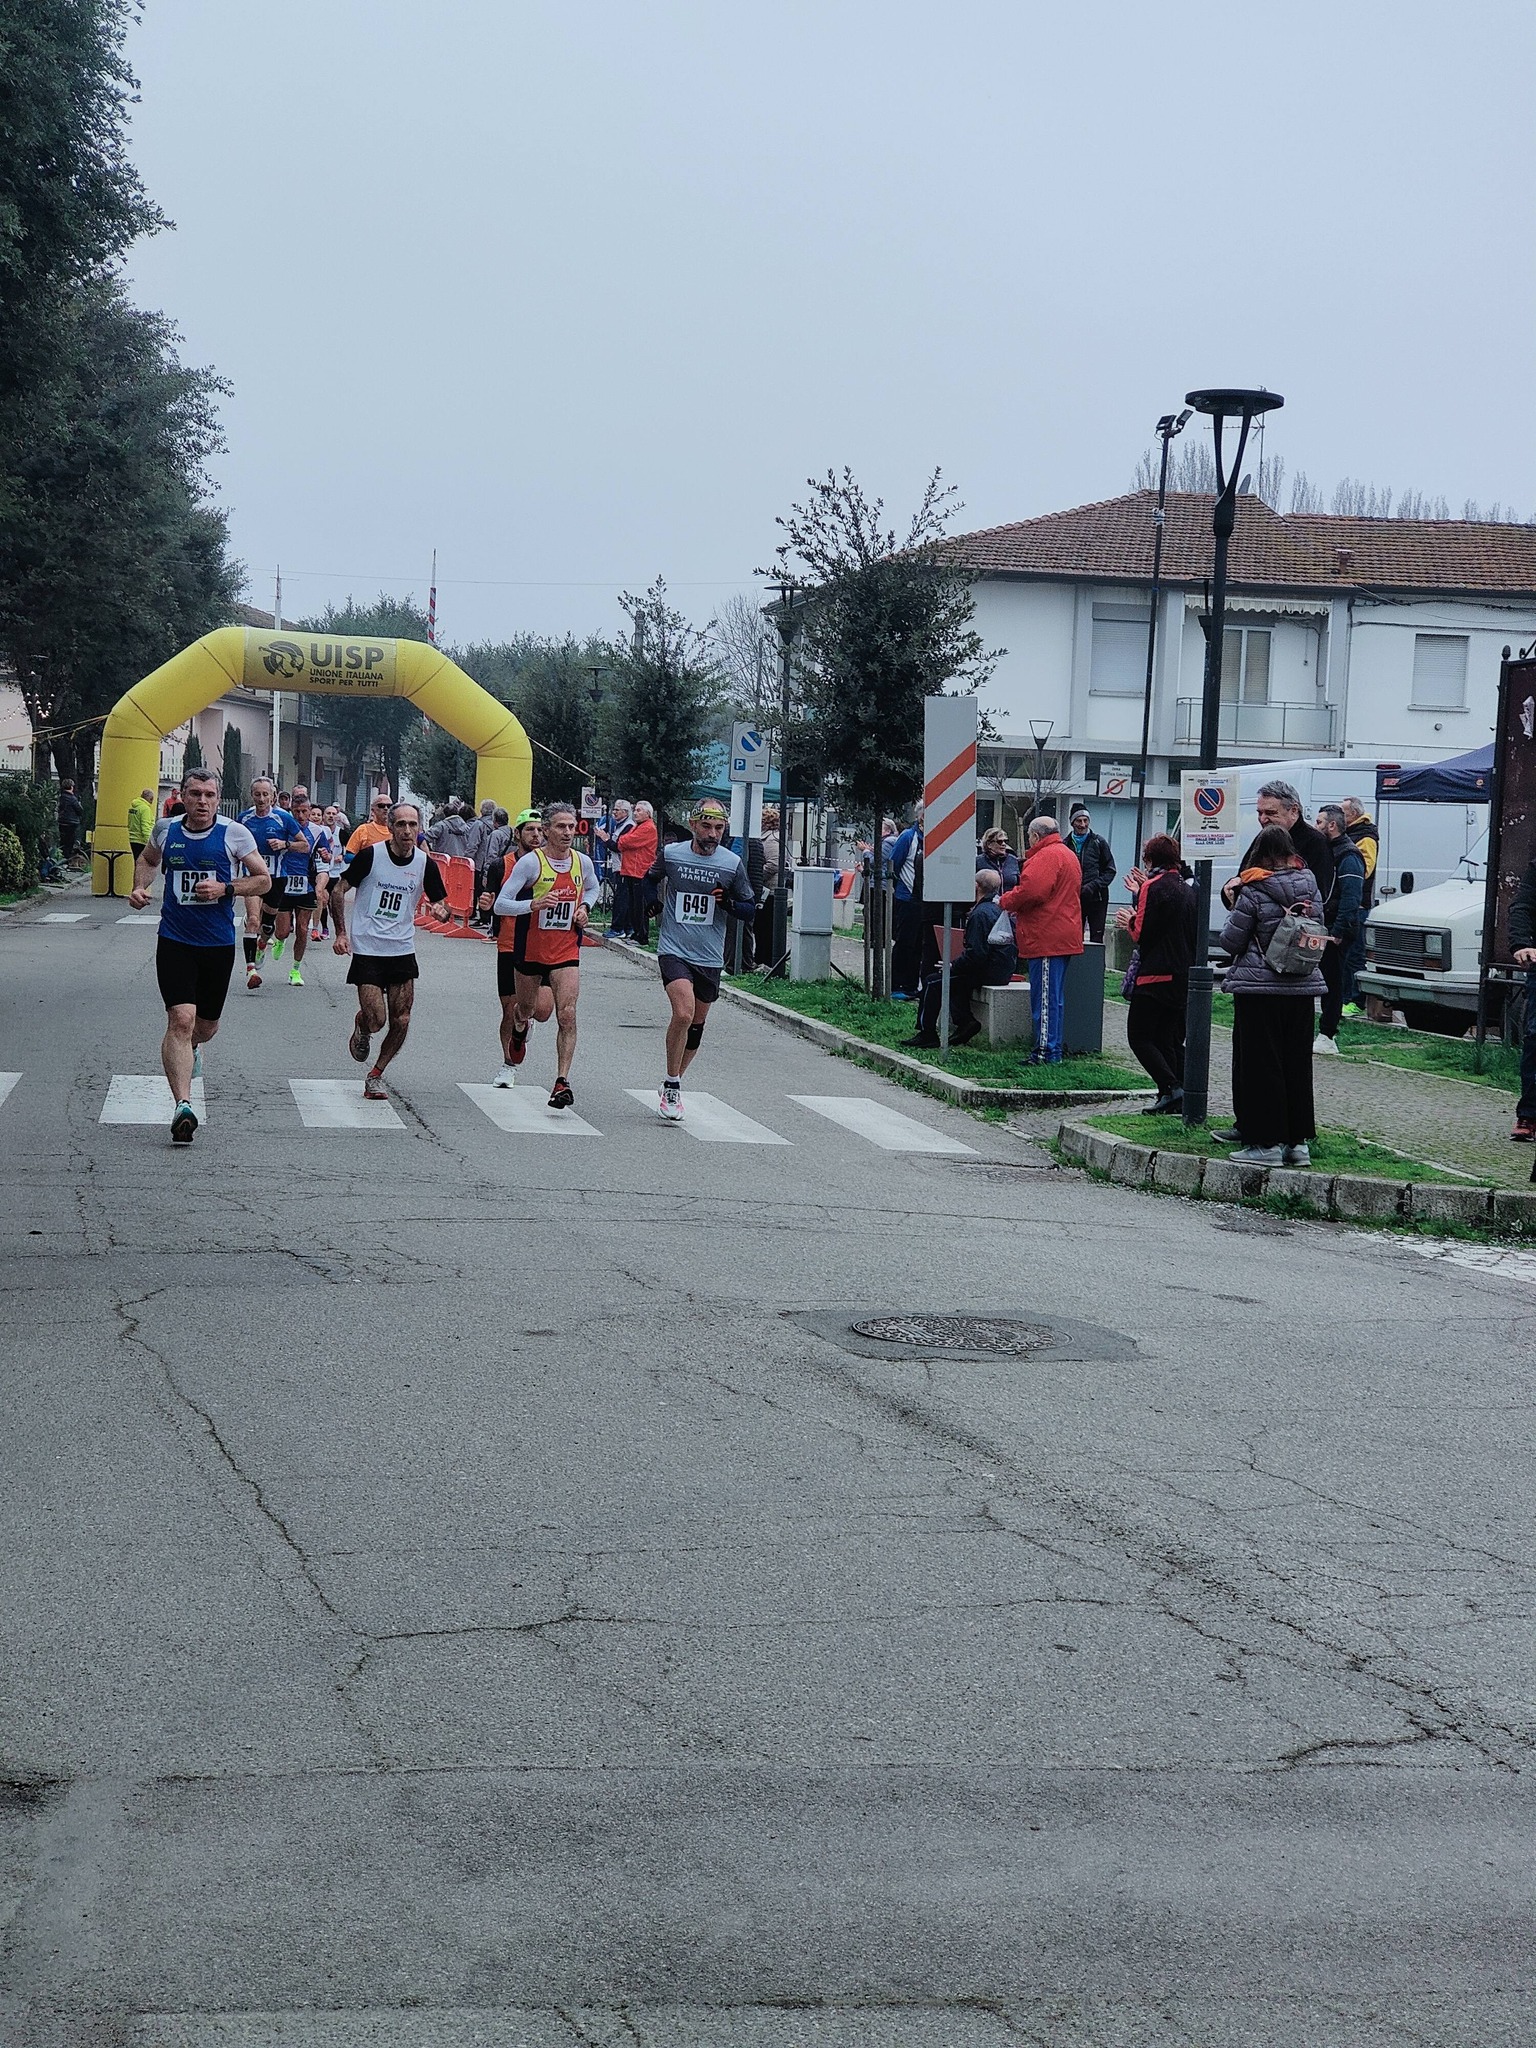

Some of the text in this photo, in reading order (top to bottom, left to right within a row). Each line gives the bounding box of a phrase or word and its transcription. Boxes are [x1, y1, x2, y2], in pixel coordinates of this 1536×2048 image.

[310, 642, 384, 670] UISP
[310, 668, 384, 681] UNIONE ITALIANA
[309, 678, 379, 688] SPORT PER TUTTI
[677, 866, 720, 878] ATLETICA
[289, 876, 304, 888] 784
[680, 873, 715, 884] MAMELI
[379, 890, 403, 911] 616
[683, 894, 709, 914] 649
